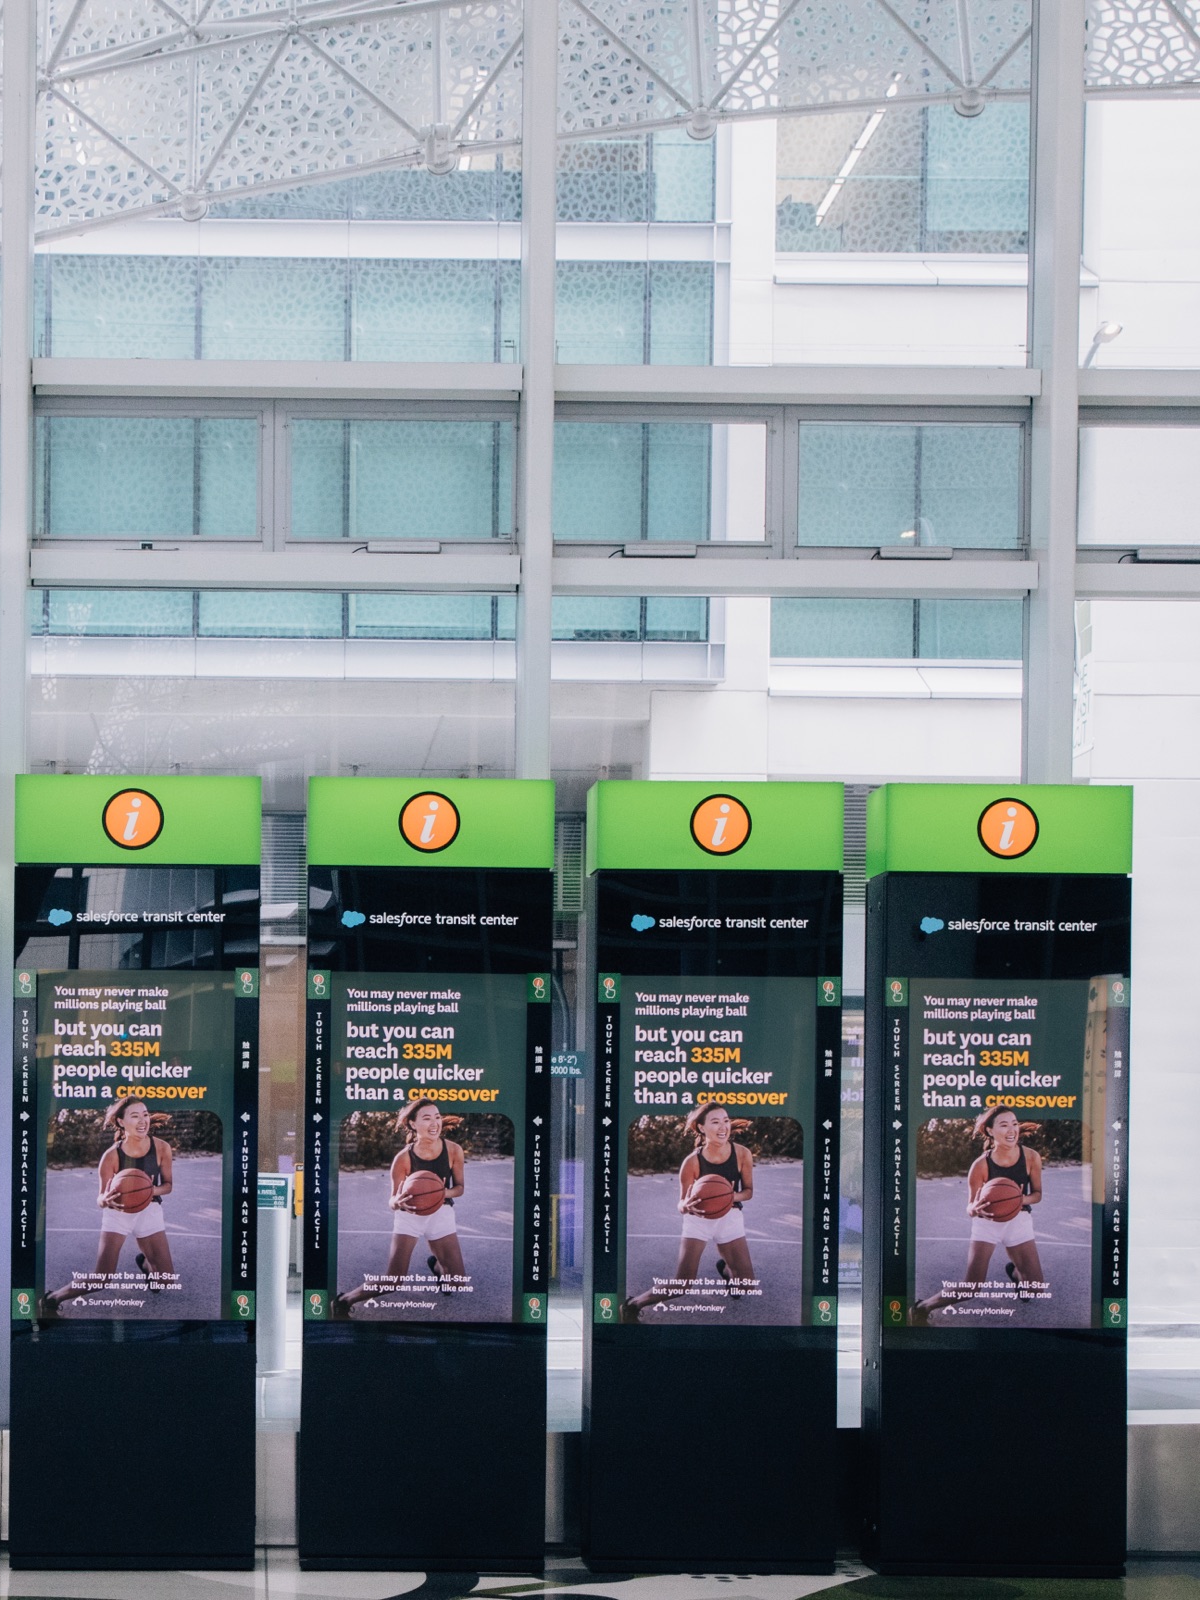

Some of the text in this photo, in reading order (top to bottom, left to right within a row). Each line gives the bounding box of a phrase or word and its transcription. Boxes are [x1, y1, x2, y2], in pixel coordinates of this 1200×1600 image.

[76, 910, 226, 925] salesforce transit center
[370, 912, 518, 927] salesforce transit center
[659, 916, 808, 931] salesforce transit center
[948, 919, 1097, 933] salesforce transit center
[55, 1019, 162, 1041] but you can
[315, 1012, 323, 1050] TOUCH
[347, 1022, 454, 1044] but you can
[635, 1025, 742, 1046] but you can
[924, 1029, 1031, 1049] but you can
[55, 1040, 159, 1056] reach 335M
[347, 1043, 451, 1059] reach 335M
[635, 1047, 740, 1062] reach 335M
[924, 1048, 1028, 1065] reach 335M
[54, 1061, 192, 1081] people quicker
[346, 1064, 483, 1084] people quicker
[635, 1067, 772, 1087] people quicker
[924, 1070, 1060, 1090] people quicker
[53, 1081, 206, 1099] than a crossover
[315, 1057, 323, 1105] SCREEN
[345, 1084, 499, 1101] than a crossover
[634, 1088, 787, 1105] than a crossover
[923, 1091, 1076, 1108] than a crossover
[532, 1234, 540, 1281] TABING
